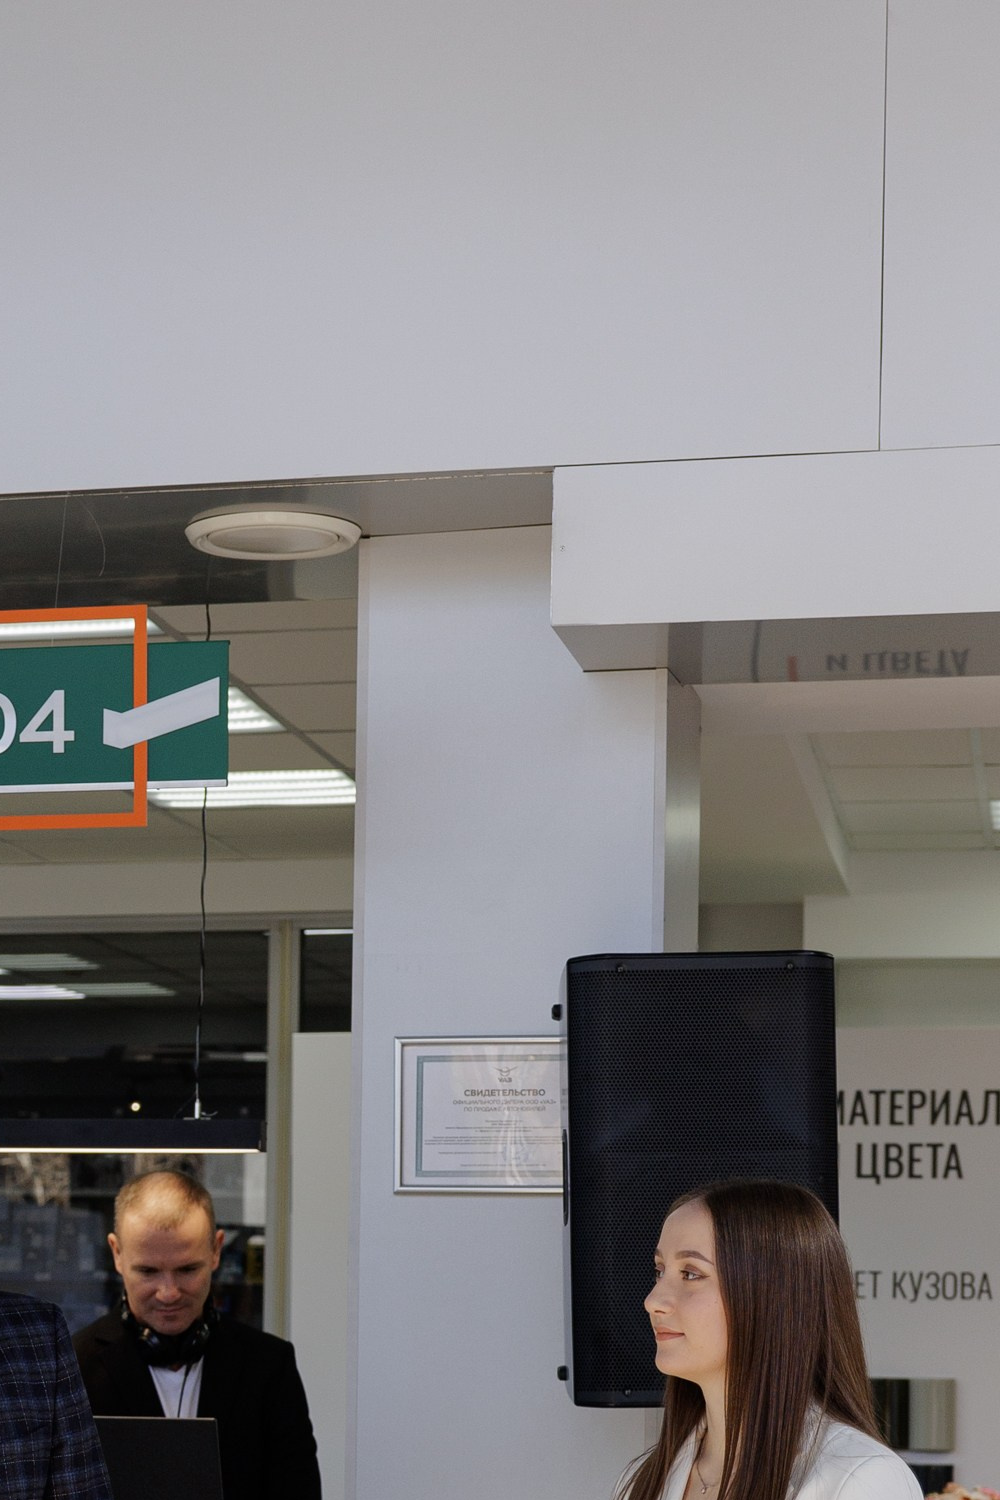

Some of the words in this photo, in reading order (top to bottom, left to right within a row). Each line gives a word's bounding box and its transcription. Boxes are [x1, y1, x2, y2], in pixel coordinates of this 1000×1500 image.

[463, 1088, 546, 1097] СВИДЕТЕЛЬСТВО
[855, 1142, 964, 1185] ЦВЕТА
[854, 1270, 882, 1299] ЕТ
[892, 1270, 993, 1304] КУЗОВА
